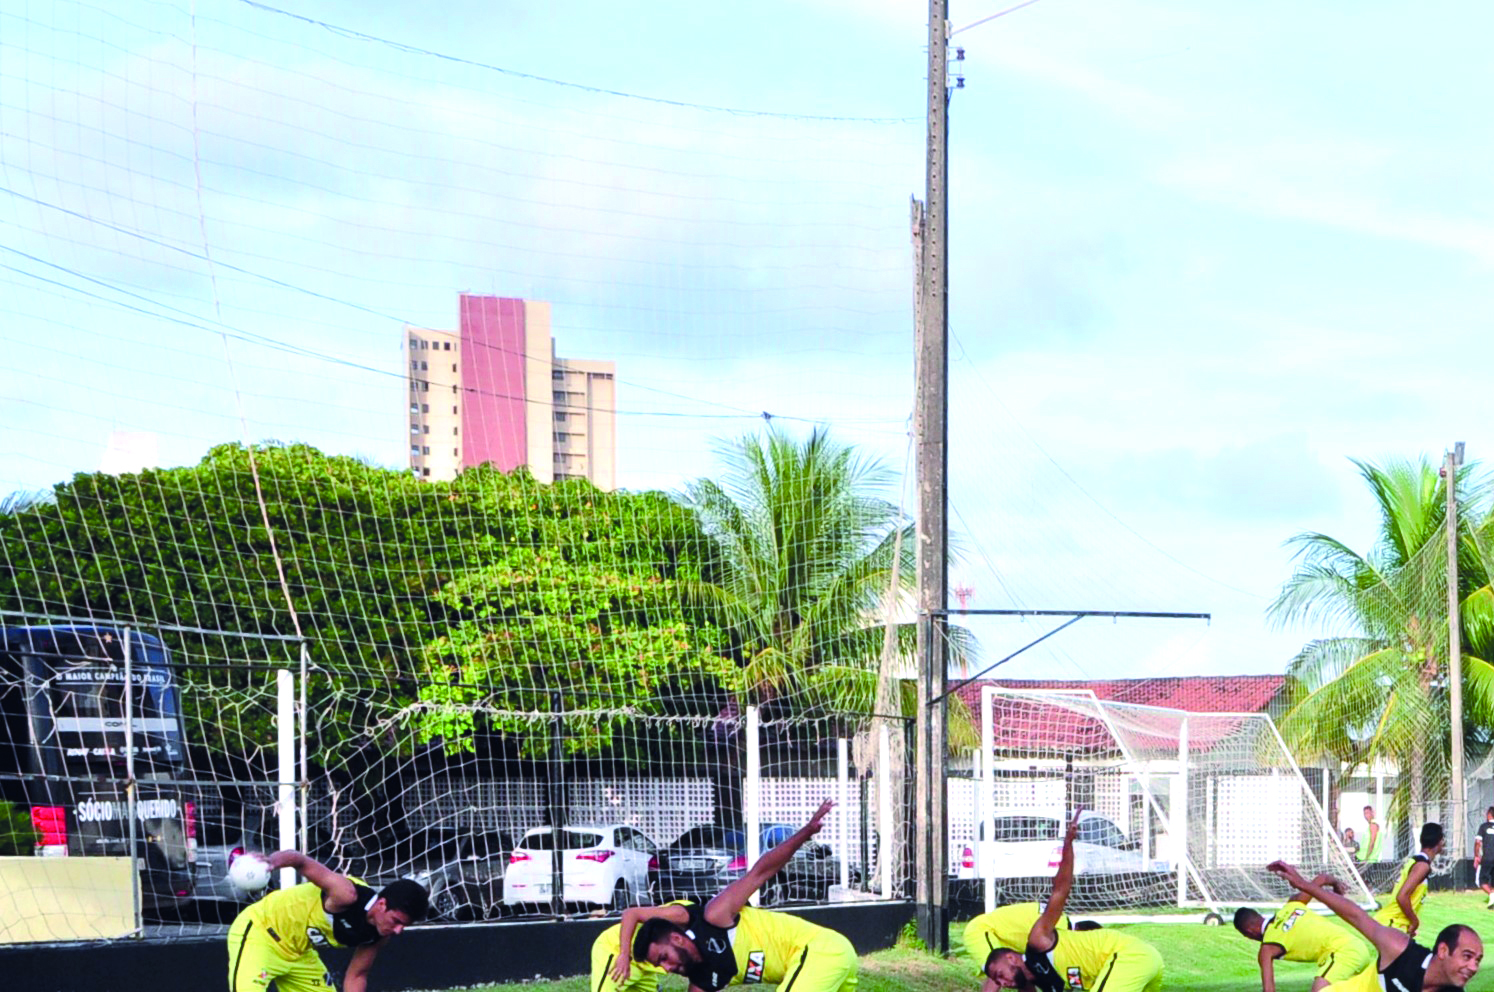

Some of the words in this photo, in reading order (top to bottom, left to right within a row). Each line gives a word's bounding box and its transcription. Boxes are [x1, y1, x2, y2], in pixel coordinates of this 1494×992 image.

[65, 672, 93, 681] MAIOR
[94, 671, 130, 682] CAMPEÃ
[78, 797, 112, 822] SÓCIO
[137, 799, 177, 820] QUERIDO
